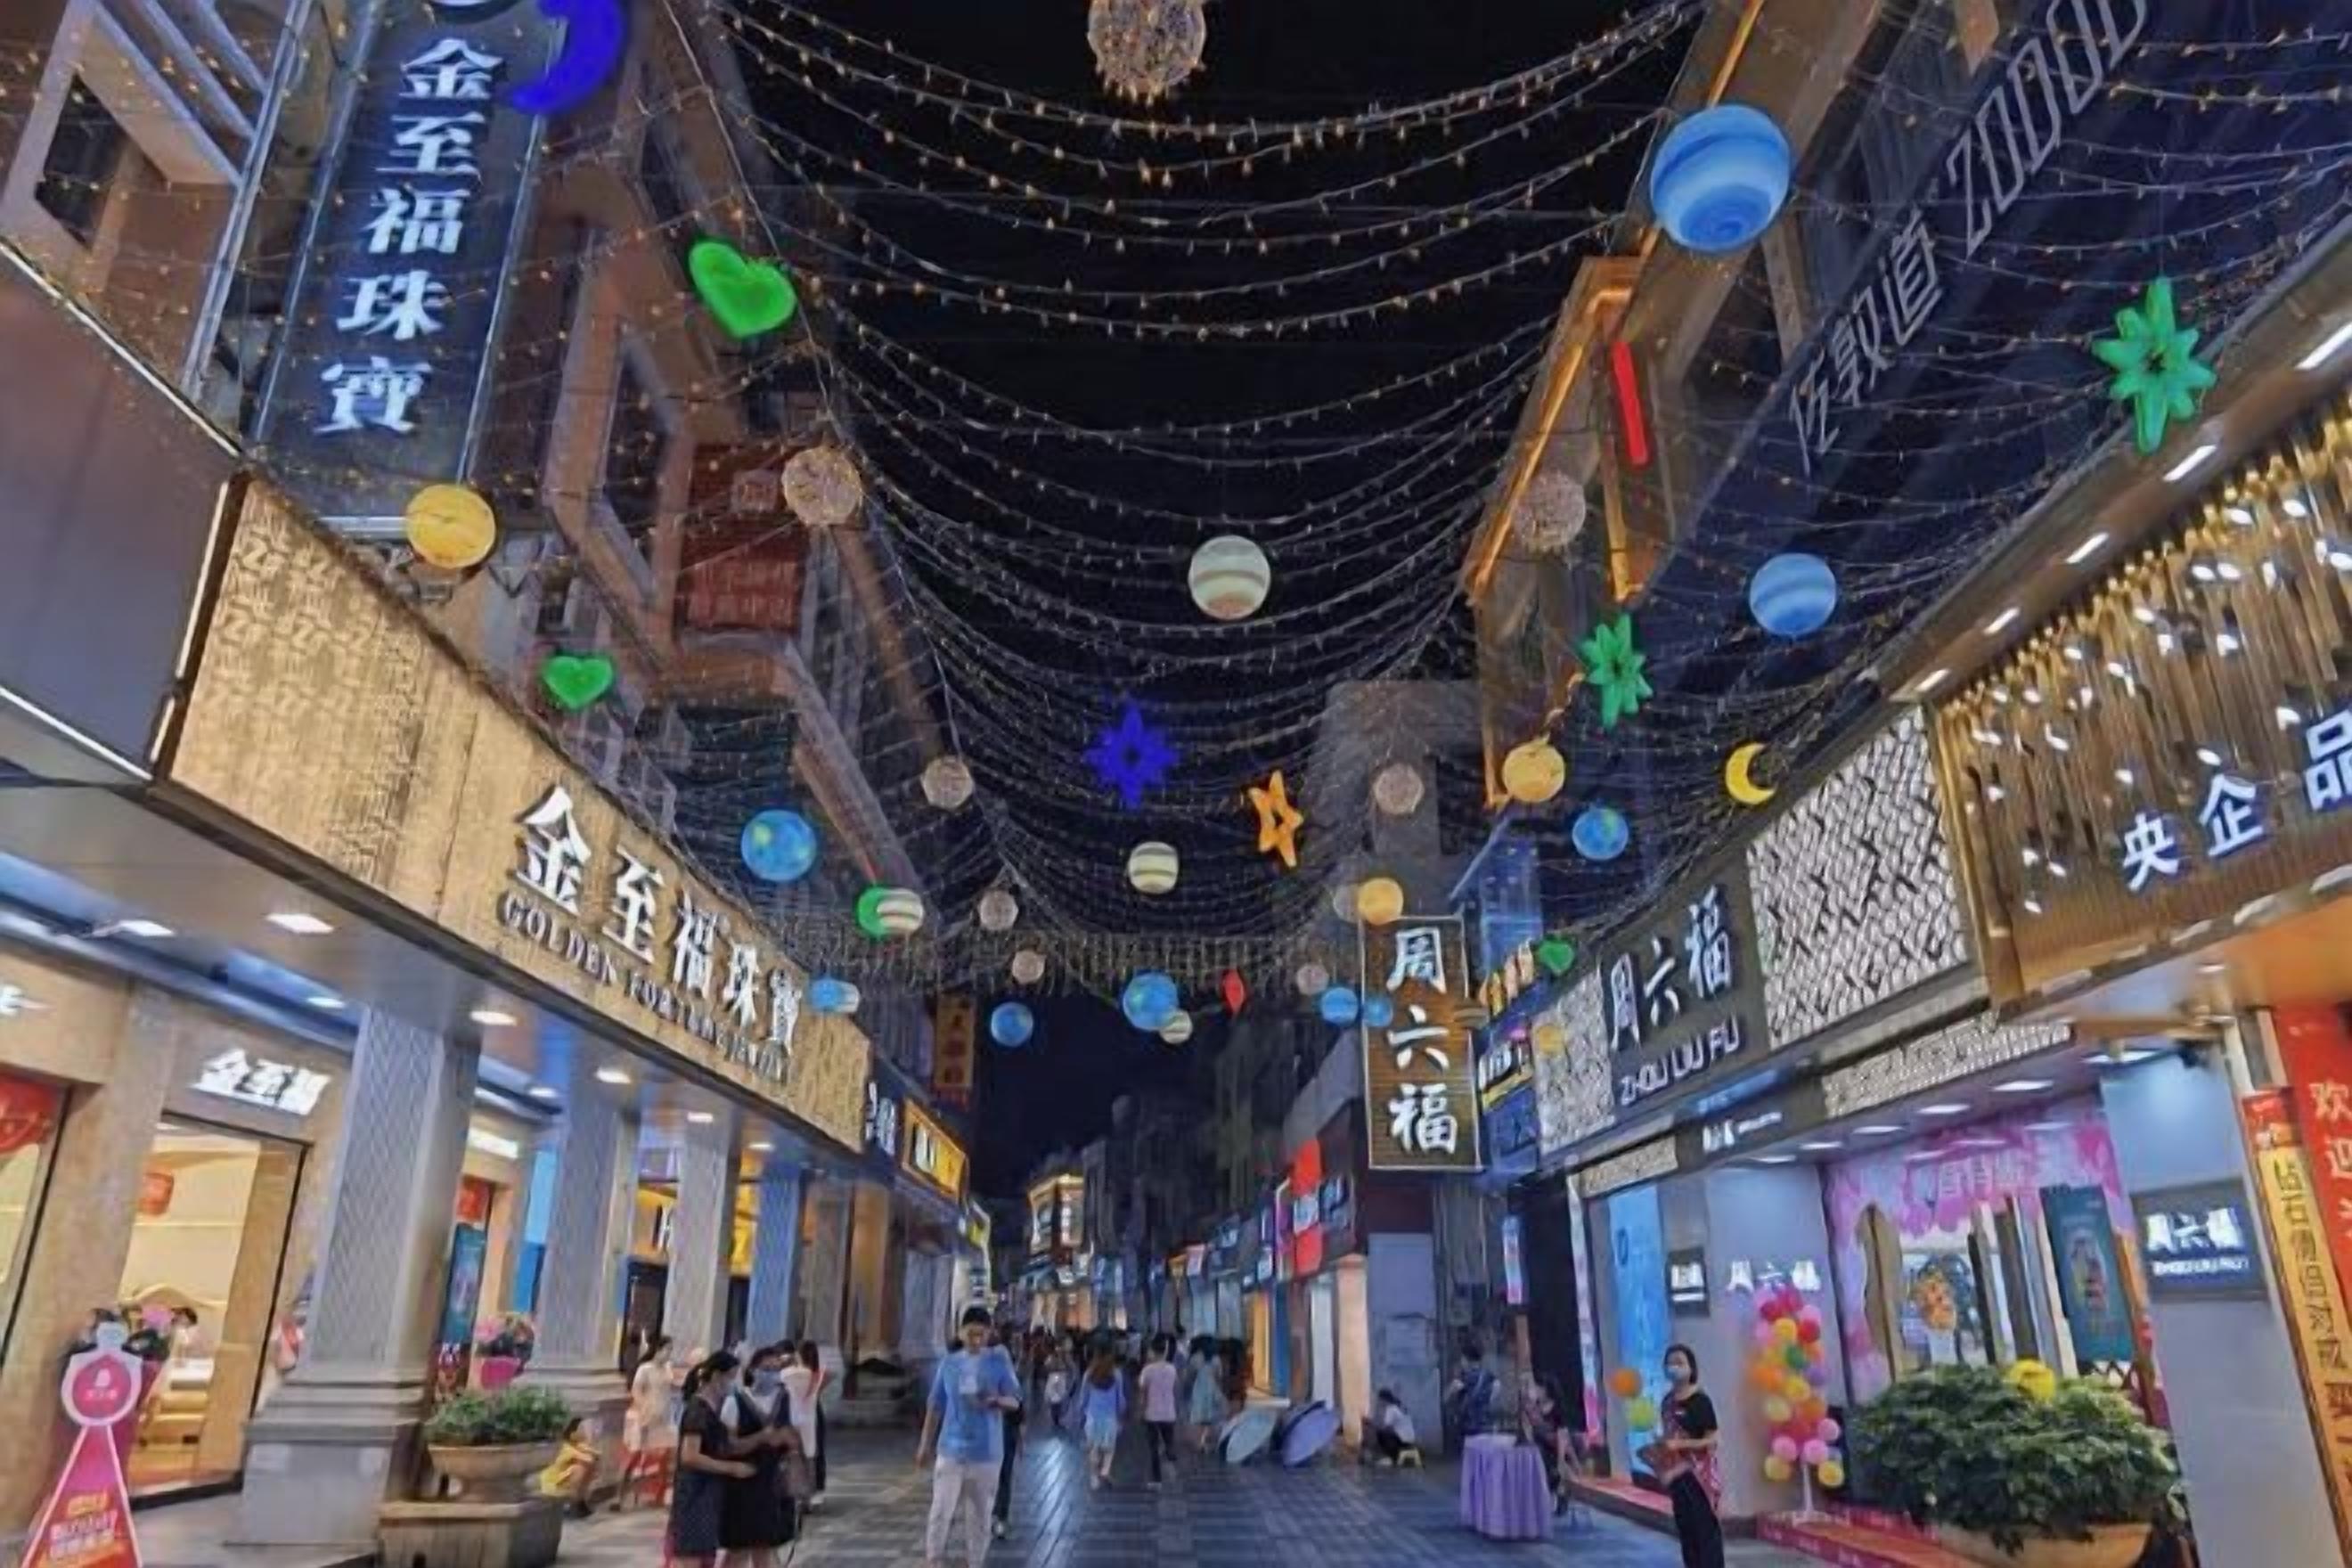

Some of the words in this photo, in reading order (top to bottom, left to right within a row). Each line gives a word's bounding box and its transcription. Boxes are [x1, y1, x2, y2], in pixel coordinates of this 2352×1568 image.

[314, 37, 502, 435] 金至福珠寶
[2123, 709, 2352, 890] 央企品
[1386, 927, 1458, 1155] 周六福
[1609, 885, 1734, 1051] 周六福
